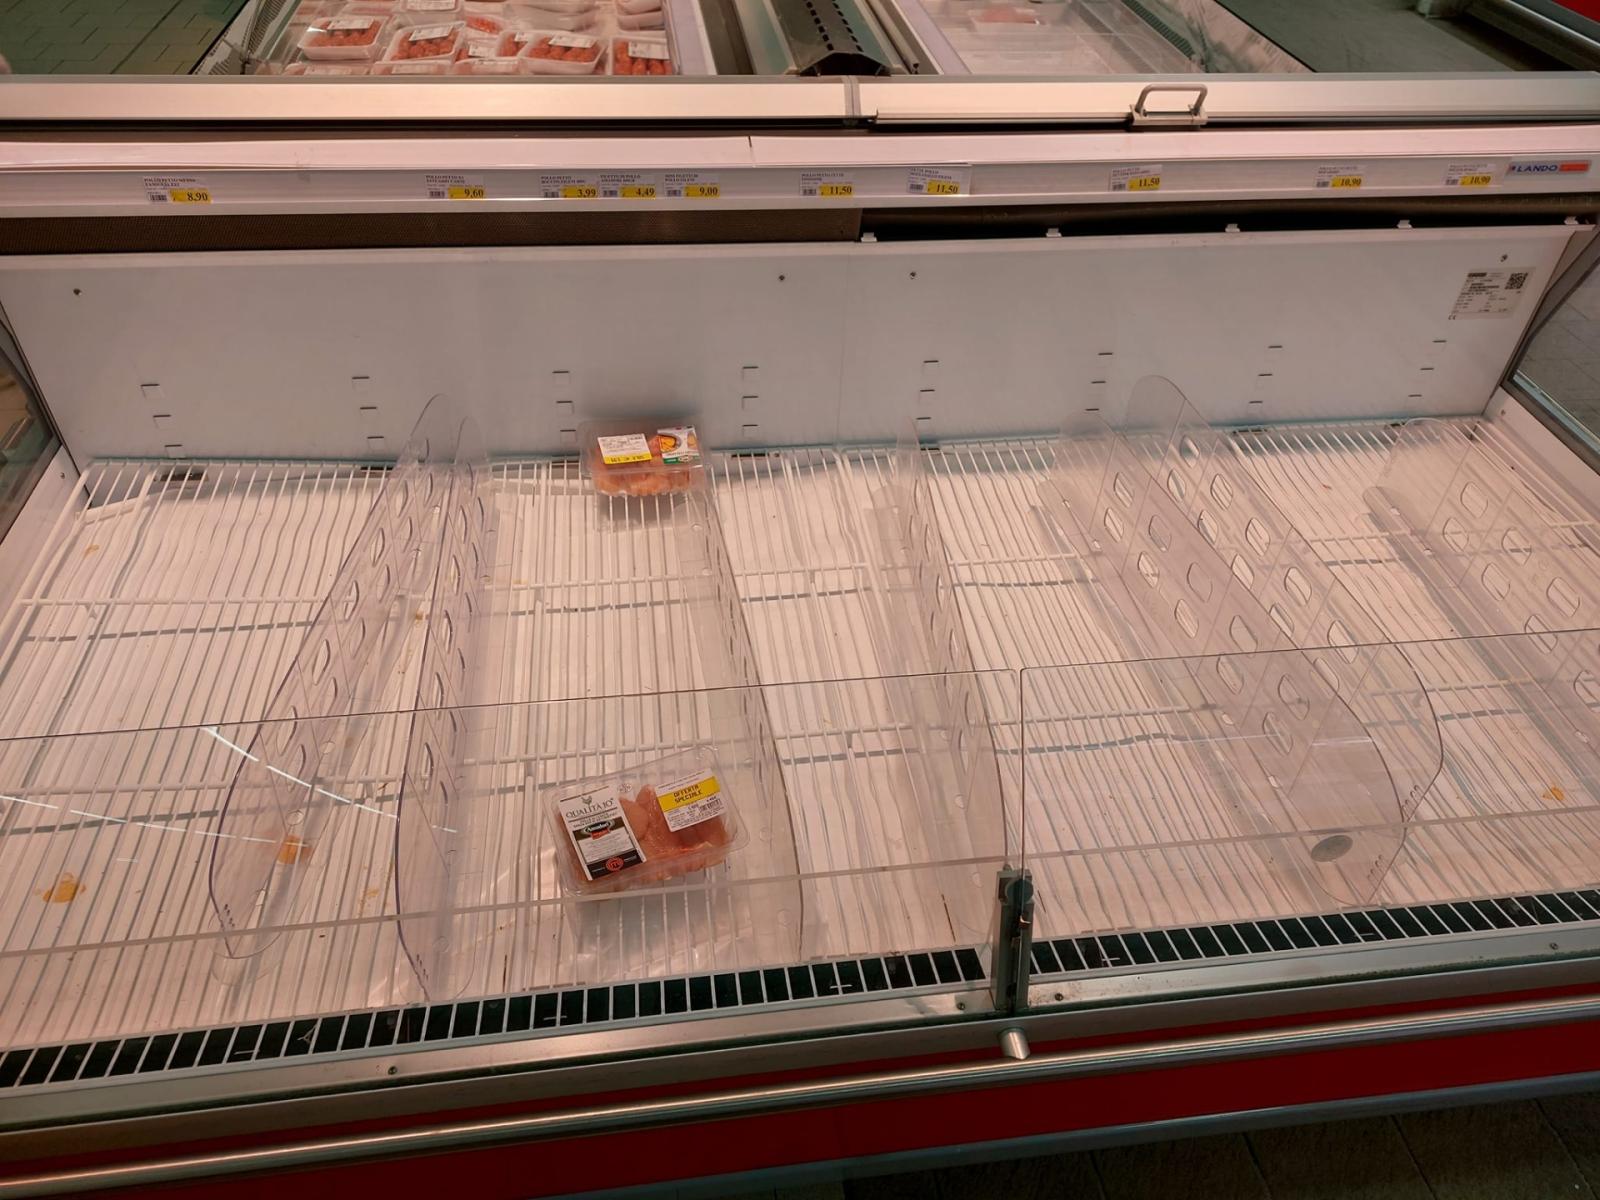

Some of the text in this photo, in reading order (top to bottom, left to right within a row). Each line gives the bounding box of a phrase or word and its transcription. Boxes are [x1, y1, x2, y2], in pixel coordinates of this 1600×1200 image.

[1516, 164, 1558, 173] LANDO
[673, 784, 699, 798] OFFERTA
[674, 790, 702, 803] SPECIALE
